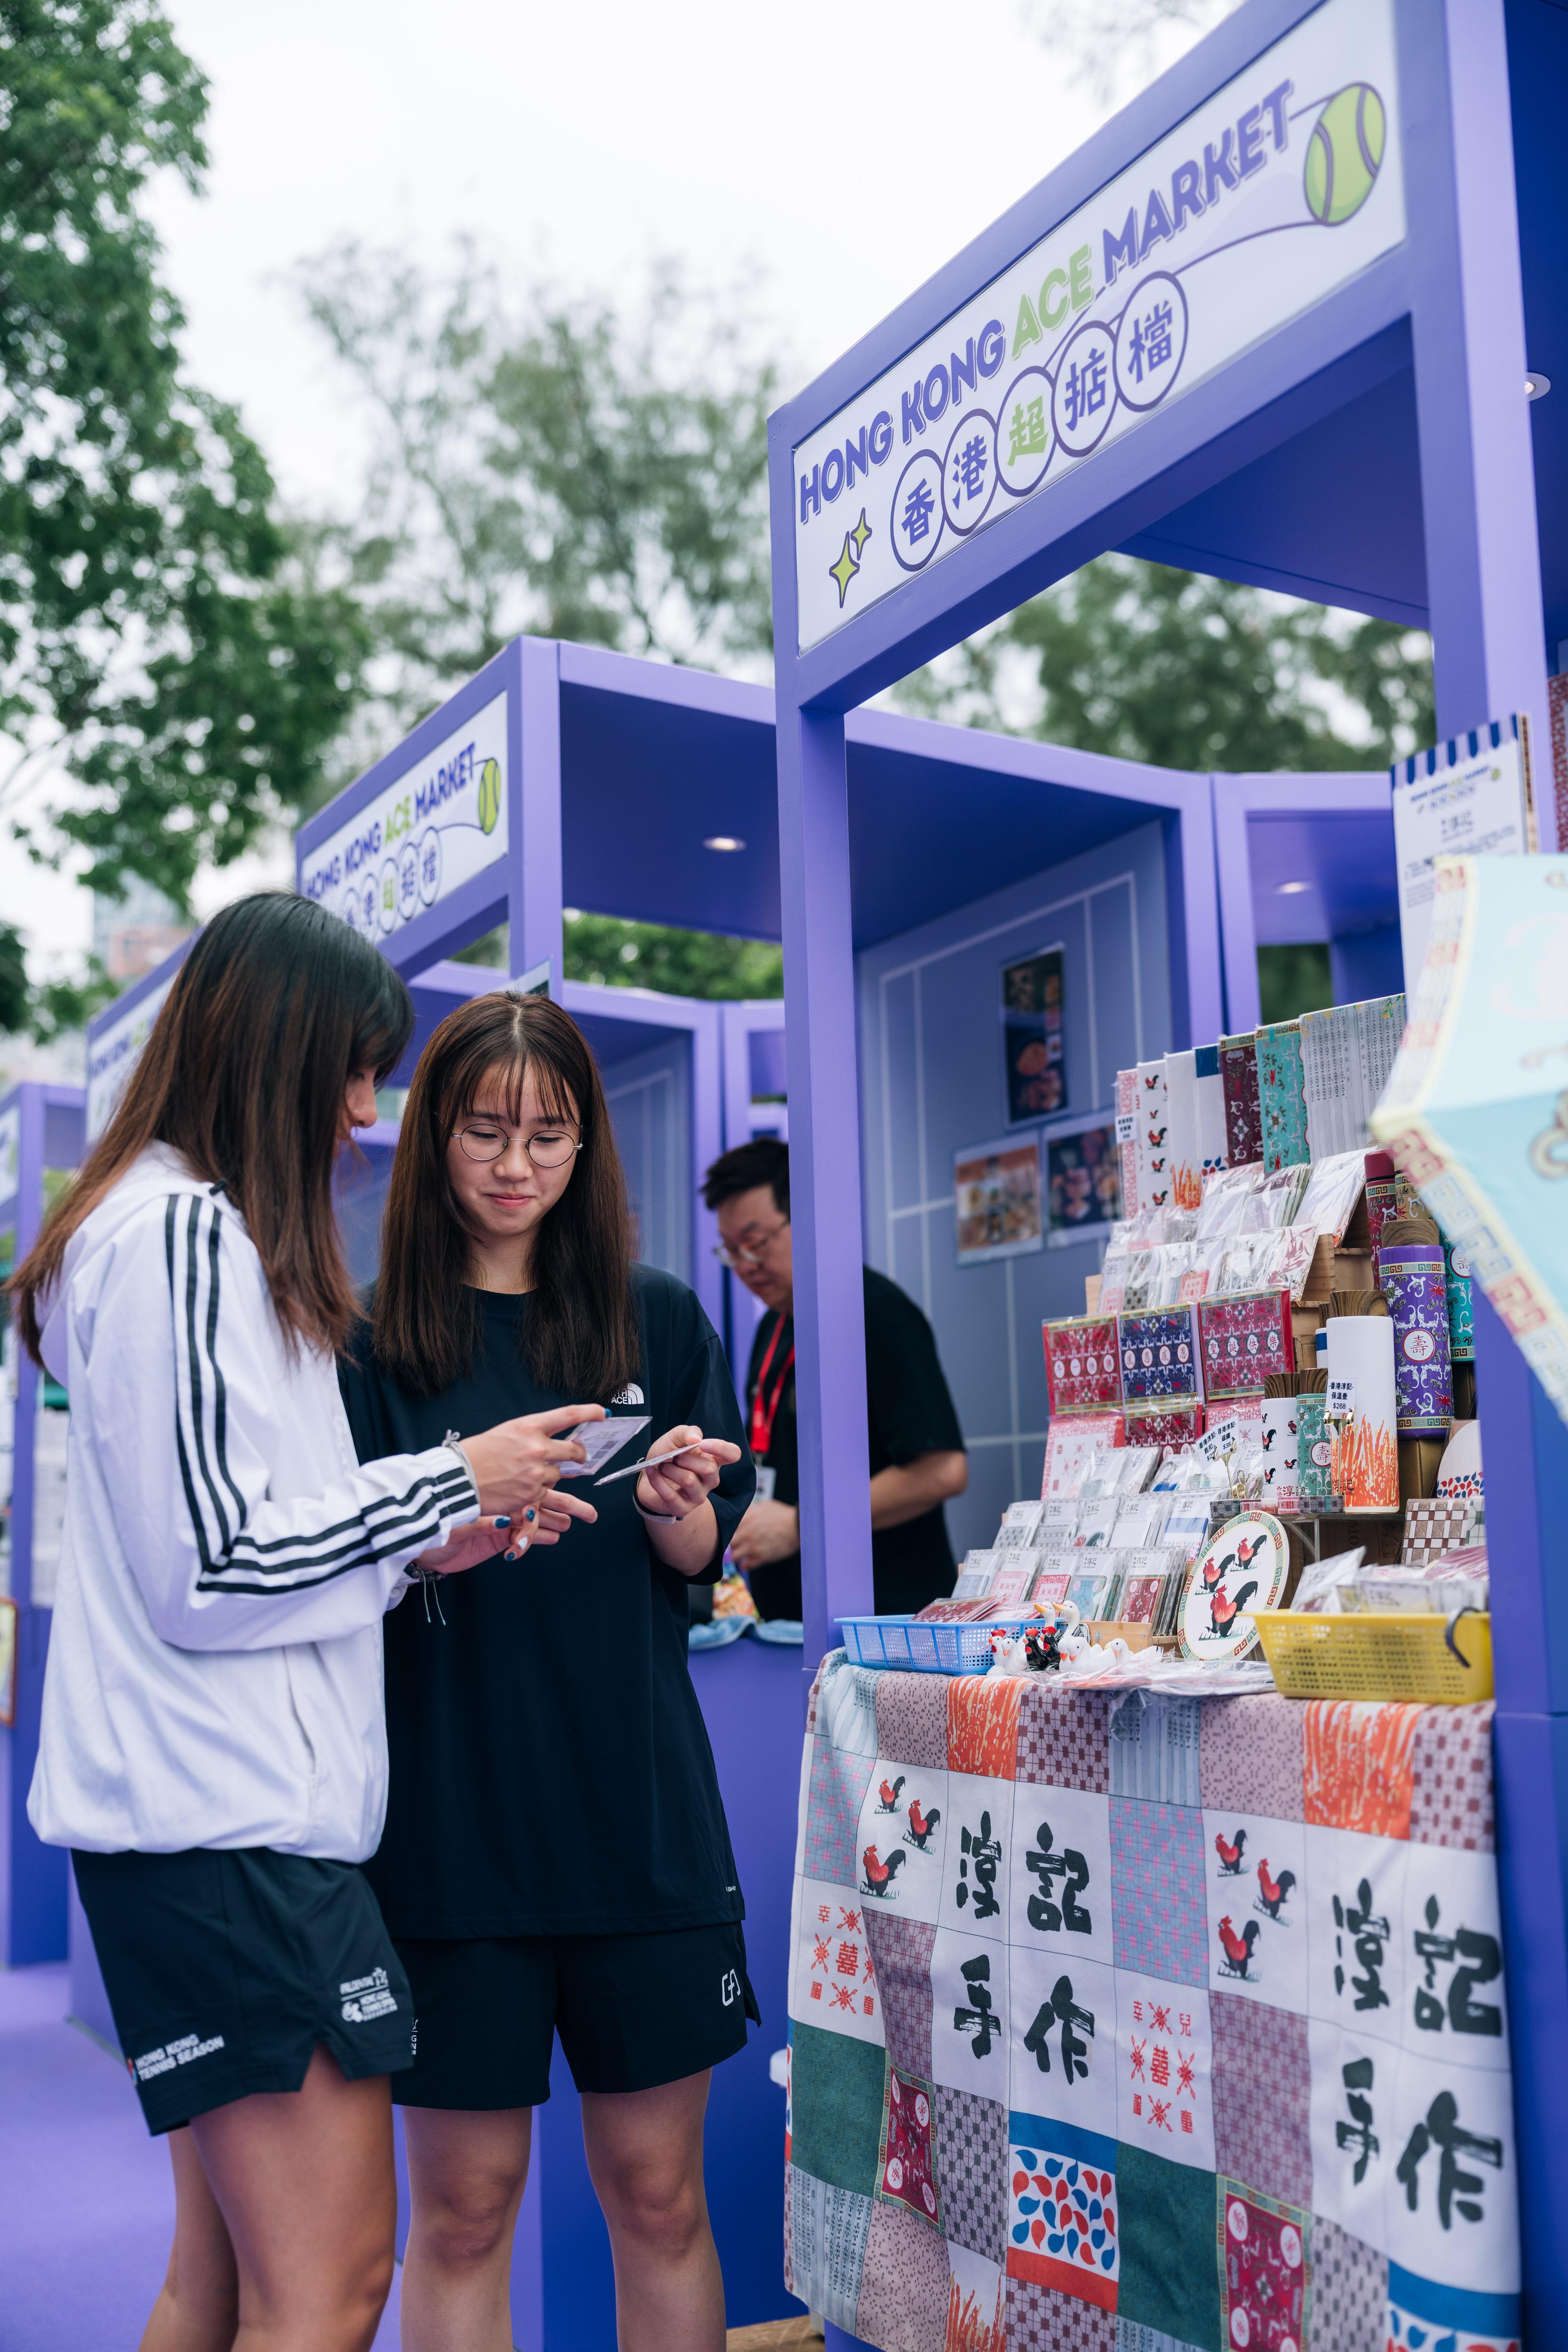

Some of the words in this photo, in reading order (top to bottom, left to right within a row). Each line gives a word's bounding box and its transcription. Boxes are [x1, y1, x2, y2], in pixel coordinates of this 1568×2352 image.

[800, 411, 893, 524] HONG
[901, 319, 1006, 446] KONG
[1012, 244, 1095, 361] ACE
[1102, 79, 1294, 288] MARKET
[901, 300, 1172, 546] 香港超掂檔
[385, 795, 412, 845] ACE
[414, 741, 475, 821] MARKET
[1210, 1335, 1277, 1355] 聖誕快樂
[1410, 1335, 1428, 1356] 壽
[1315, 1445, 1330, 1462] 壽
[956, 1811, 1092, 1935] 淳記
[818, 1905, 830, 1923] 幸
[1332, 1878, 1503, 2037] 淳記
[135, 2048, 166, 2070] HONG
[165, 2034, 200, 2057] KONG
[954, 1954, 1095, 2085] 手作
[1133, 2000, 1143, 2022] 幸
[1179, 2013, 1191, 2037] 兒
[138, 2055, 176, 2081] TENNIS
[176, 2035, 225, 2065] SEASON
[1337, 2057, 1503, 2231] 手作
